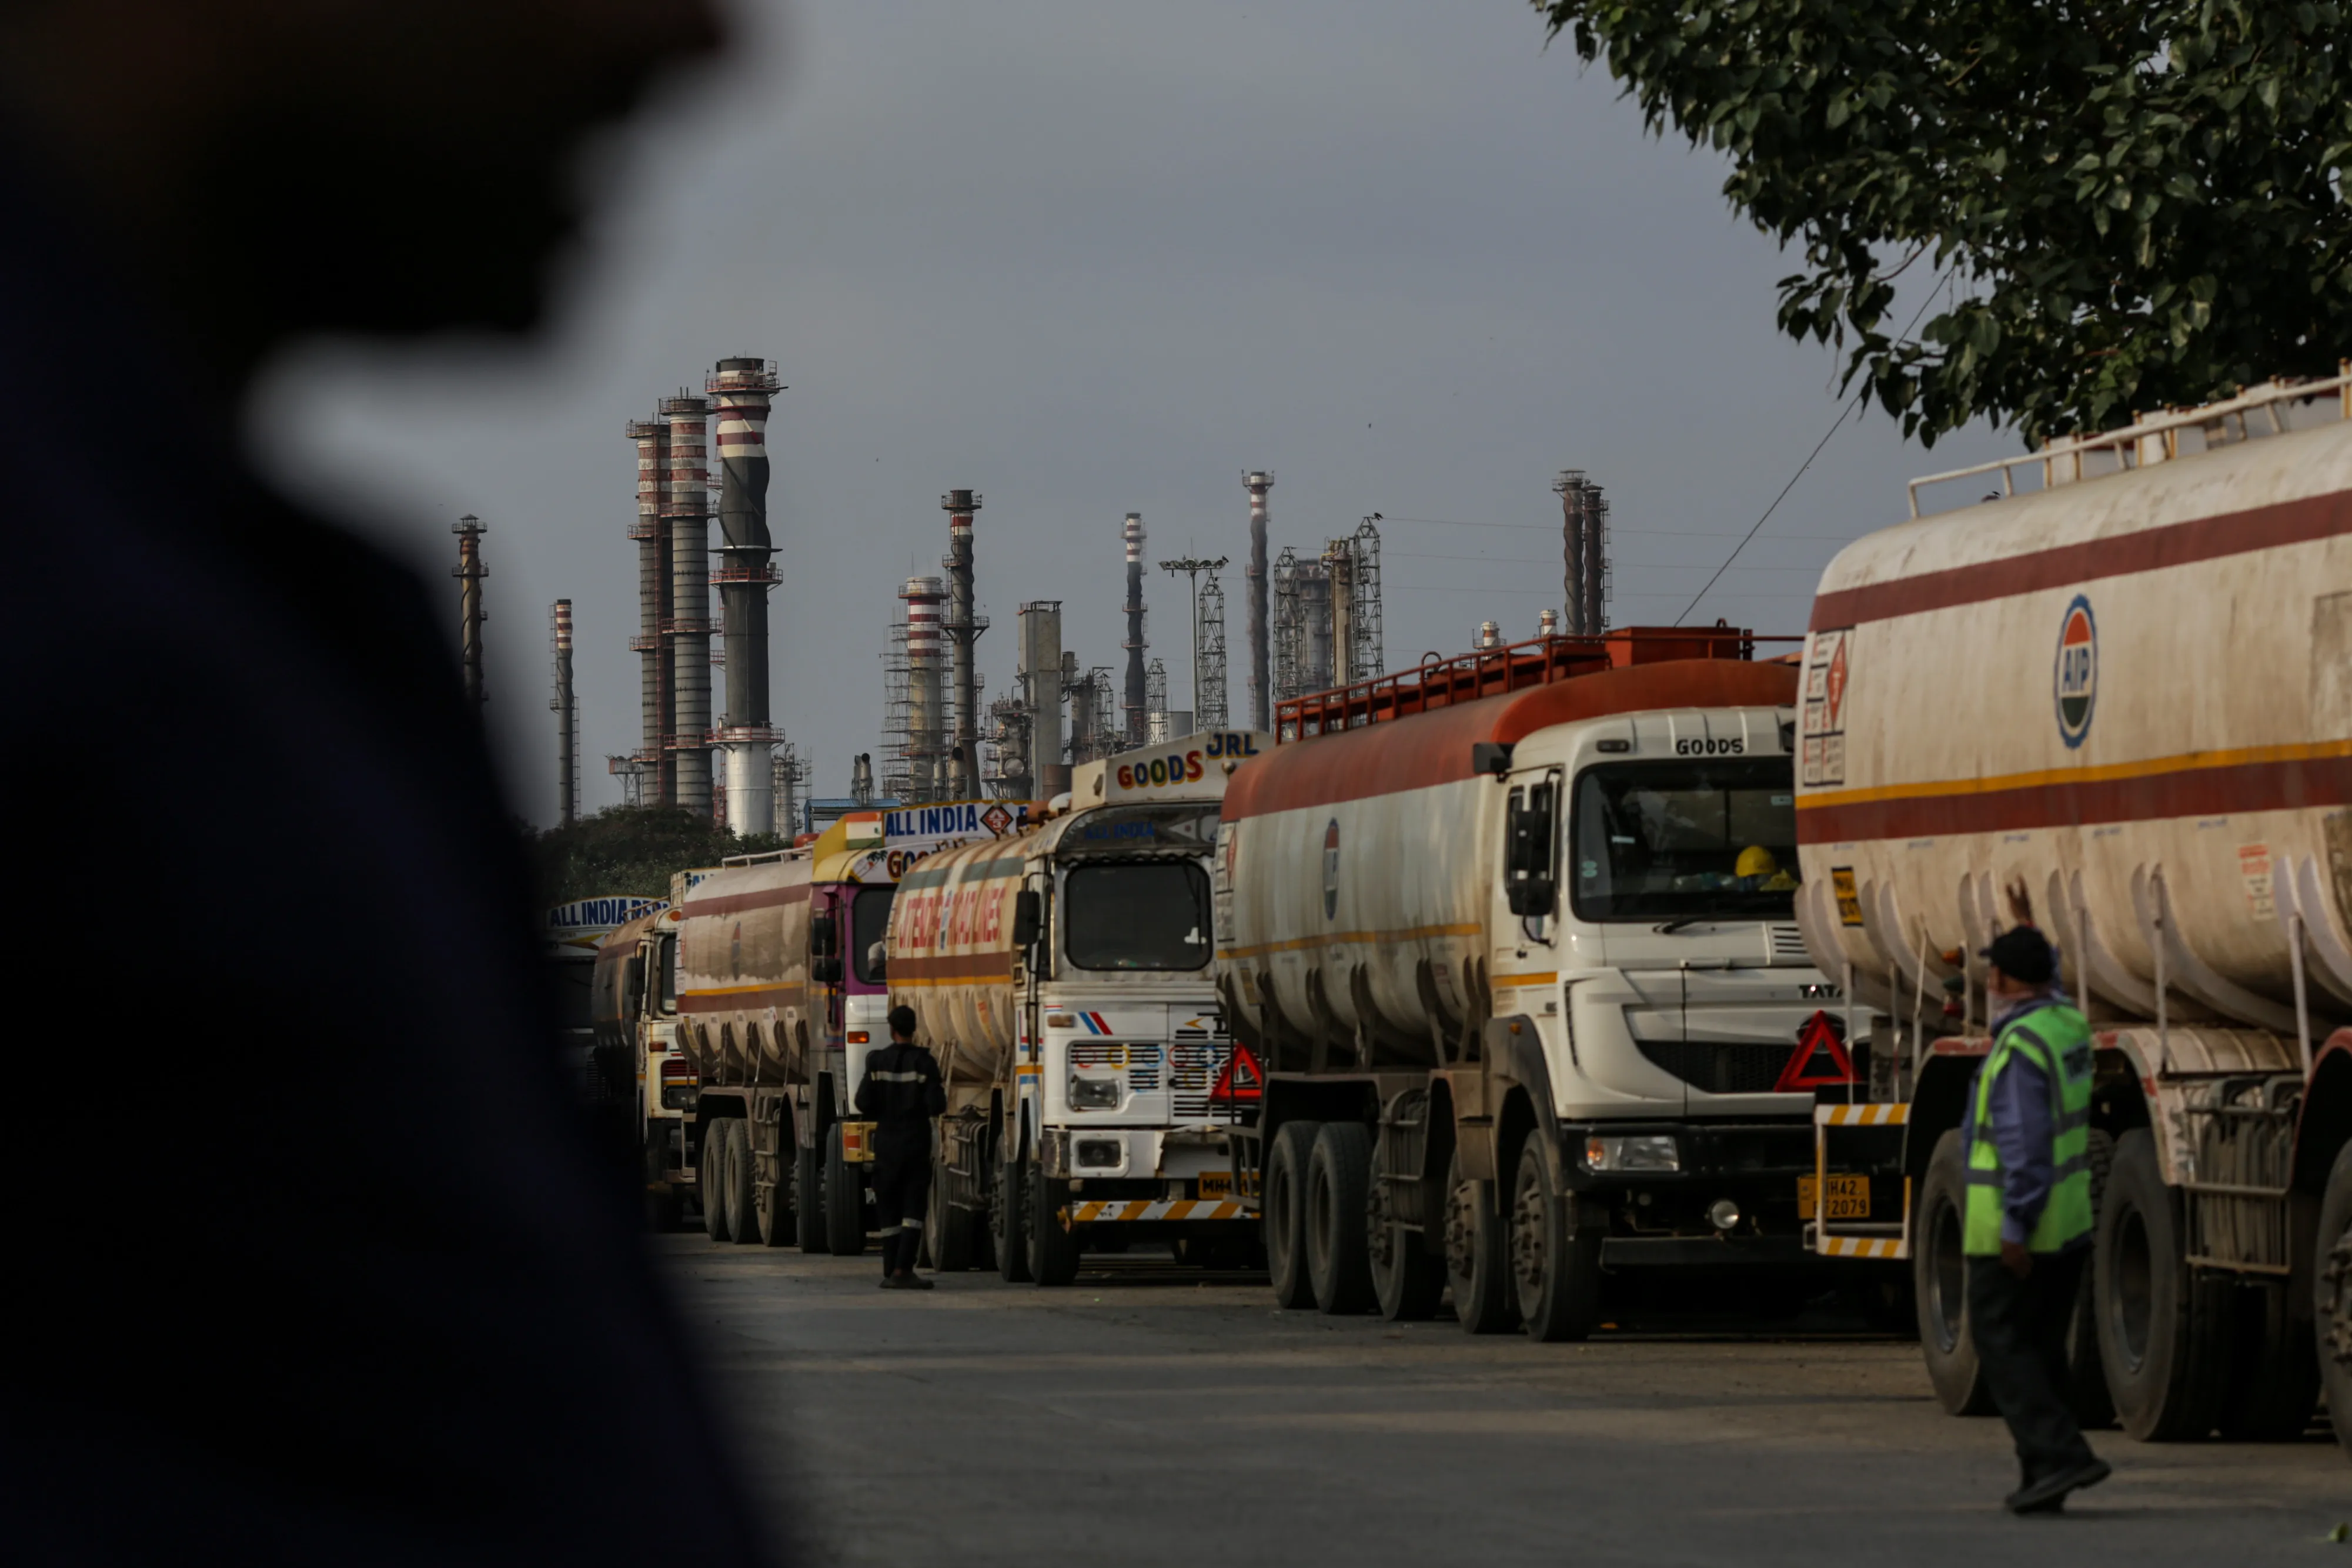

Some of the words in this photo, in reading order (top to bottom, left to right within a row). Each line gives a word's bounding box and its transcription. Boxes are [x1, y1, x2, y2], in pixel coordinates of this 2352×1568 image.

[1207, 733, 1259, 759] JRL
[1676, 738, 1744, 755] GOODS
[1117, 750, 1204, 790] GOODS
[886, 811, 916, 836] ALL
[920, 805, 978, 835] INDIA
[1085, 825, 1110, 840] ALL
[1113, 821, 1155, 839] INDIA
[550, 905, 580, 927] ALL
[582, 899, 627, 925] INDIA
